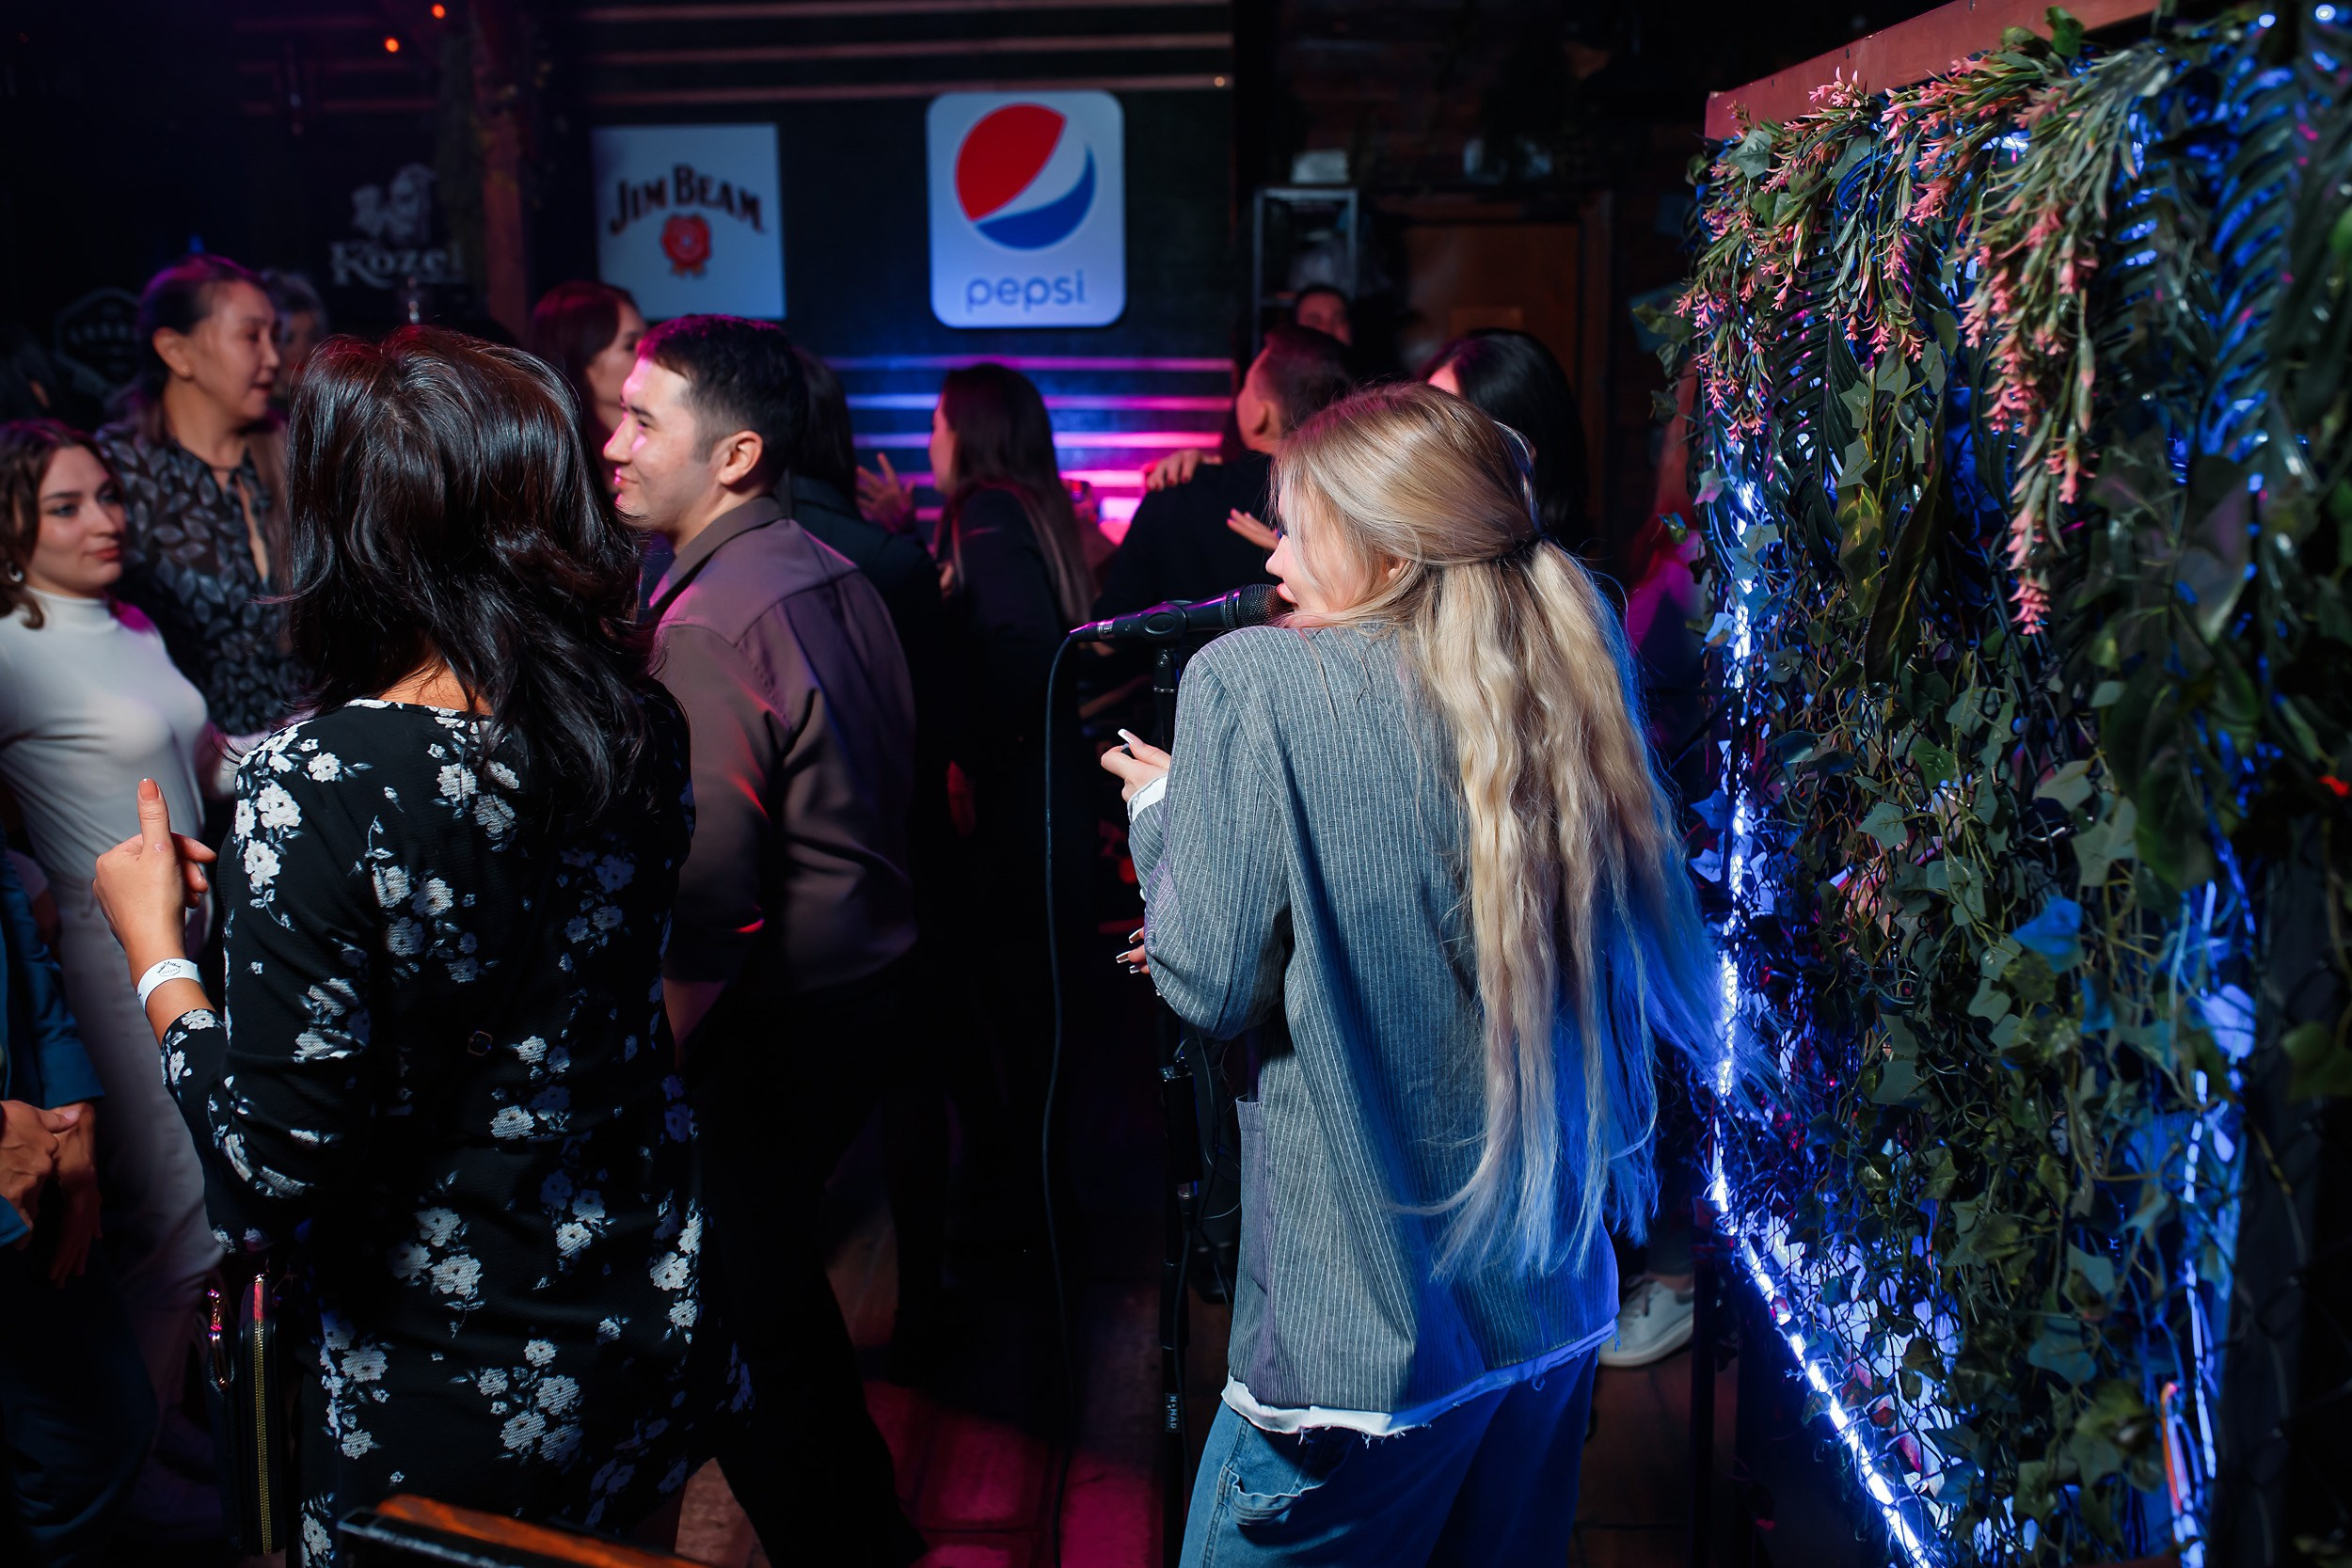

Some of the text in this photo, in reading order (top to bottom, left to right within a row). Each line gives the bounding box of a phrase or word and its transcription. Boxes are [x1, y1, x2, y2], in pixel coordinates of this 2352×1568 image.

[611, 164, 766, 234] JIM BEAM
[330, 241, 464, 289] Kozel
[966, 269, 1085, 313] pepsi
